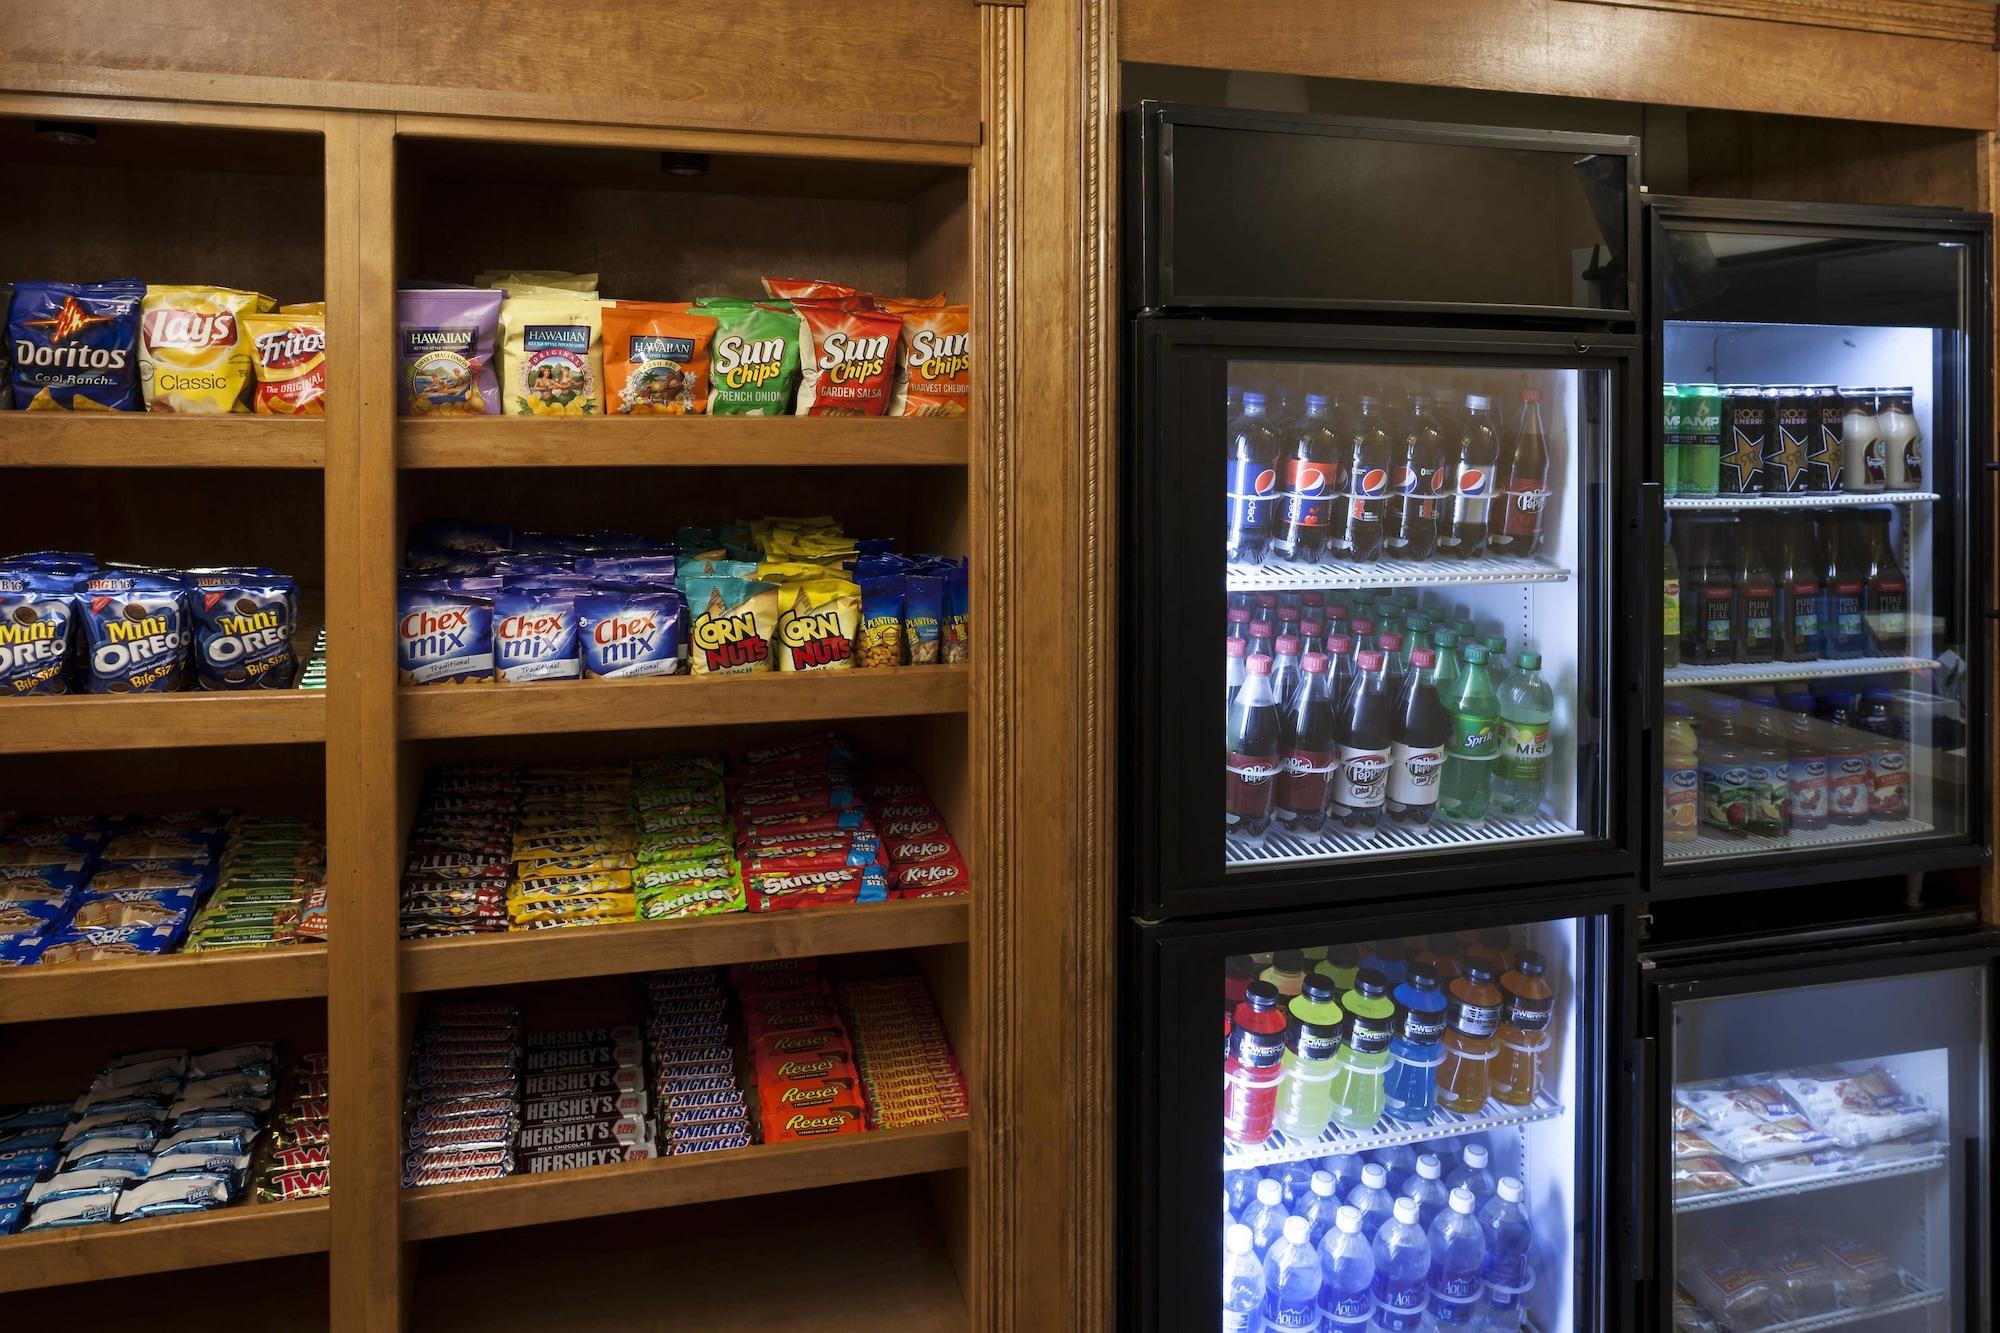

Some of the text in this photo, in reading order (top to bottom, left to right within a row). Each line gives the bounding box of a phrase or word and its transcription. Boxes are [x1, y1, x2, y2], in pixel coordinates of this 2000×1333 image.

[150, 310, 234, 348] Lay's
[411, 332, 472, 344] HAWAIIAN
[529, 331, 585, 342] HAWAIIAN
[16, 340, 127, 369] Doritos
[255, 330, 325, 367] Fritos
[635, 342, 690, 353] HAWAIIAN
[716, 336, 785, 374] Sun
[819, 333, 890, 370] Sun
[908, 331, 969, 366] Sun
[533, 350, 580, 366] ORIGINAL
[920, 354, 969, 380] Chips
[35, 373, 108, 385] Cool Ranch
[727, 361, 781, 389] Chips
[830, 358, 884, 384] Chips
[160, 374, 227, 391] Classic
[266, 373, 324, 394] The ORIGINAL
[821, 386, 882, 398] GARDEN SALSA
[912, 384, 943, 393] HARVEST
[719, 391, 784, 402] FRENCH ONION
[1681, 415, 1720, 426] AMP
[88, 579, 130, 591] BIG BAG
[107, 616, 167, 644] Mini
[220, 611, 279, 636] Mini
[400, 605, 472, 640] Chex
[498, 611, 567, 640] Chex
[594, 610, 659, 640] Chex
[694, 611, 756, 651] CORN
[779, 610, 839, 650] CORN
[867, 616, 899, 629] PLANTERS
[905, 616, 938, 629] PLANTERS
[0, 620, 56, 647] Mini
[408, 626, 467, 660] mix
[94, 632, 180, 674] OREO
[208, 625, 289, 662] OREO
[502, 631, 561, 659] mix
[602, 631, 657, 665] mix
[246, 662, 270, 676] Bite
[429, 657, 471, 673] Traditional
[521, 661, 561, 674] Traditional
[622, 661, 659, 678] Traditional
[129, 674, 157, 689] Bite
[643, 866, 729, 889] Skittles
[763, 870, 854, 895] Skittles
[647, 889, 734, 919] Skittles
[773, 1032, 829, 1050] Reese's
[528, 1046, 610, 1070] HERSHEY'S
[662, 1047, 733, 1063] SNICKERS
[663, 1064, 731, 1077] SNICKERS
[777, 1058, 834, 1076] Reese's
[872, 1065, 929, 1080] Starburst
[525, 1070, 611, 1094] HERSHEY'S
[664, 1076, 734, 1093] SNICKERS
[877, 1075, 933, 1090] Starburst
[672, 1089, 742, 1107] SNICKERS
[781, 1086, 840, 1103] Reese's
[879, 1085, 934, 1100] Starburst
[432, 1098, 512, 1118] Musketeers
[526, 1096, 613, 1121] HERSHEY'S
[883, 1095, 939, 1110] Starburst
[673, 1105, 744, 1122] SNICKERS
[785, 1114, 846, 1130] Reese's
[882, 1105, 939, 1121] Starburst
[425, 1115, 507, 1135] Musketeers
[521, 1121, 610, 1148] HERSHEY'S
[674, 1120, 746, 1139] SNICKERS
[423, 1130, 507, 1147] Musketeers
[554, 1142, 592, 1150] CHOCOLATE
[676, 1135, 749, 1154] SNICKERS
[421, 1150, 506, 1169] Musketeers
[416, 1167, 504, 1186] Musketeers
